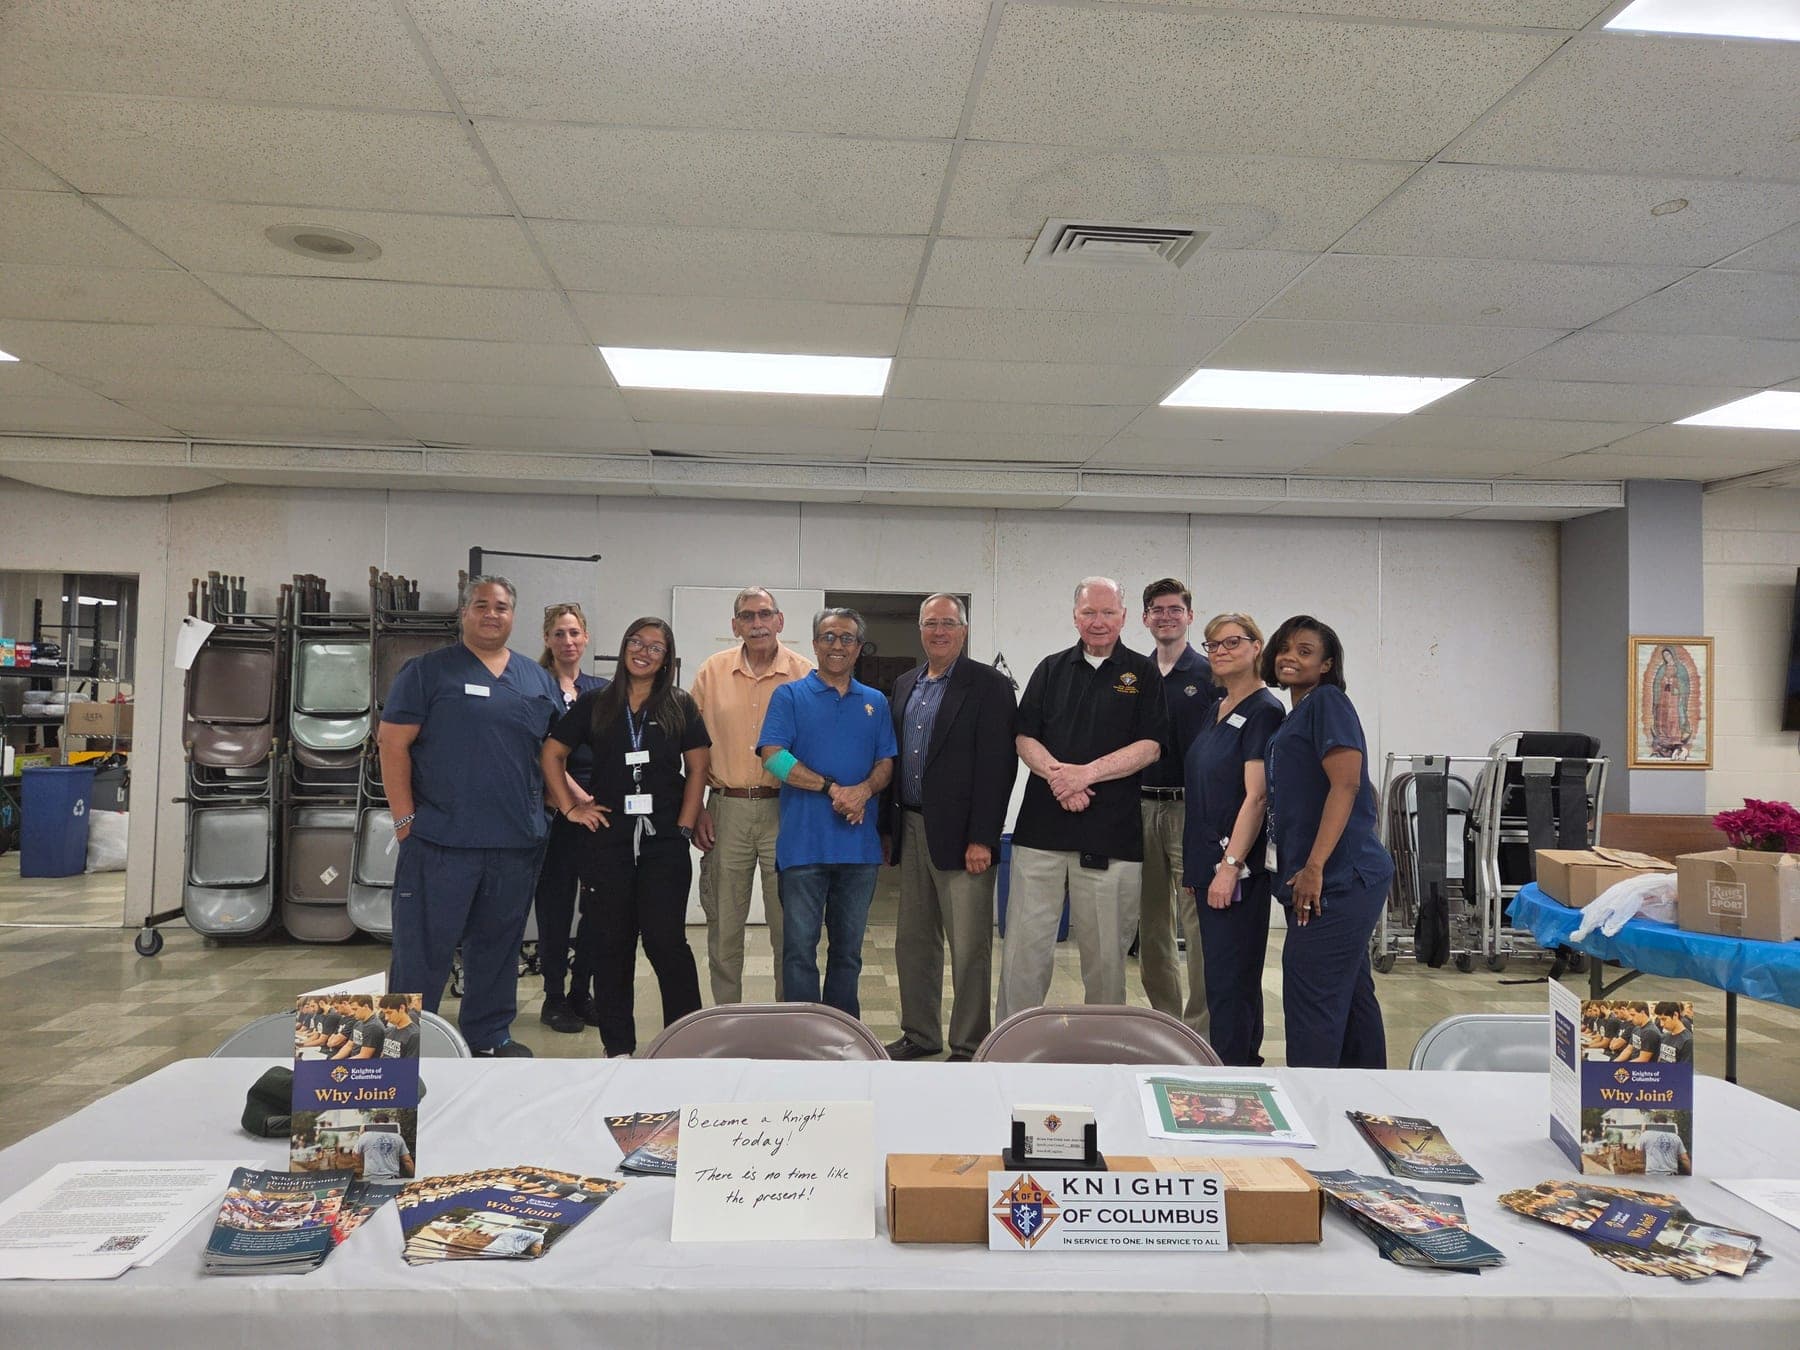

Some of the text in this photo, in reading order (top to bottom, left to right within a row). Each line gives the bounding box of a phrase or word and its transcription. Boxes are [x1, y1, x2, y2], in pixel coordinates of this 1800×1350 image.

[1711, 899, 1743, 910] SPORT
[351, 1067, 375, 1075] Knights
[1631, 1070, 1651, 1078] Knights
[314, 1086, 397, 1104] Why Join?
[1600, 1088, 1674, 1104] Why Join?
[687, 1108, 749, 1129] Become
[782, 1106, 826, 1132] Knight
[1364, 1112, 1394, 1126] 24
[732, 1130, 793, 1157] today!
[695, 1166, 849, 1183] There is no time like
[1062, 1177, 1218, 1196] KNIGHTS
[726, 1186, 815, 1209] the present!
[1011, 1191, 1019, 1202] K
[1033, 1191, 1042, 1202] C
[486, 1200, 562, 1219] Why Join?
[1062, 1208, 1219, 1224] OF COLUMBUS
[1063, 1237, 1073, 1245] IN
[1145, 1237, 1155, 1245] IN
